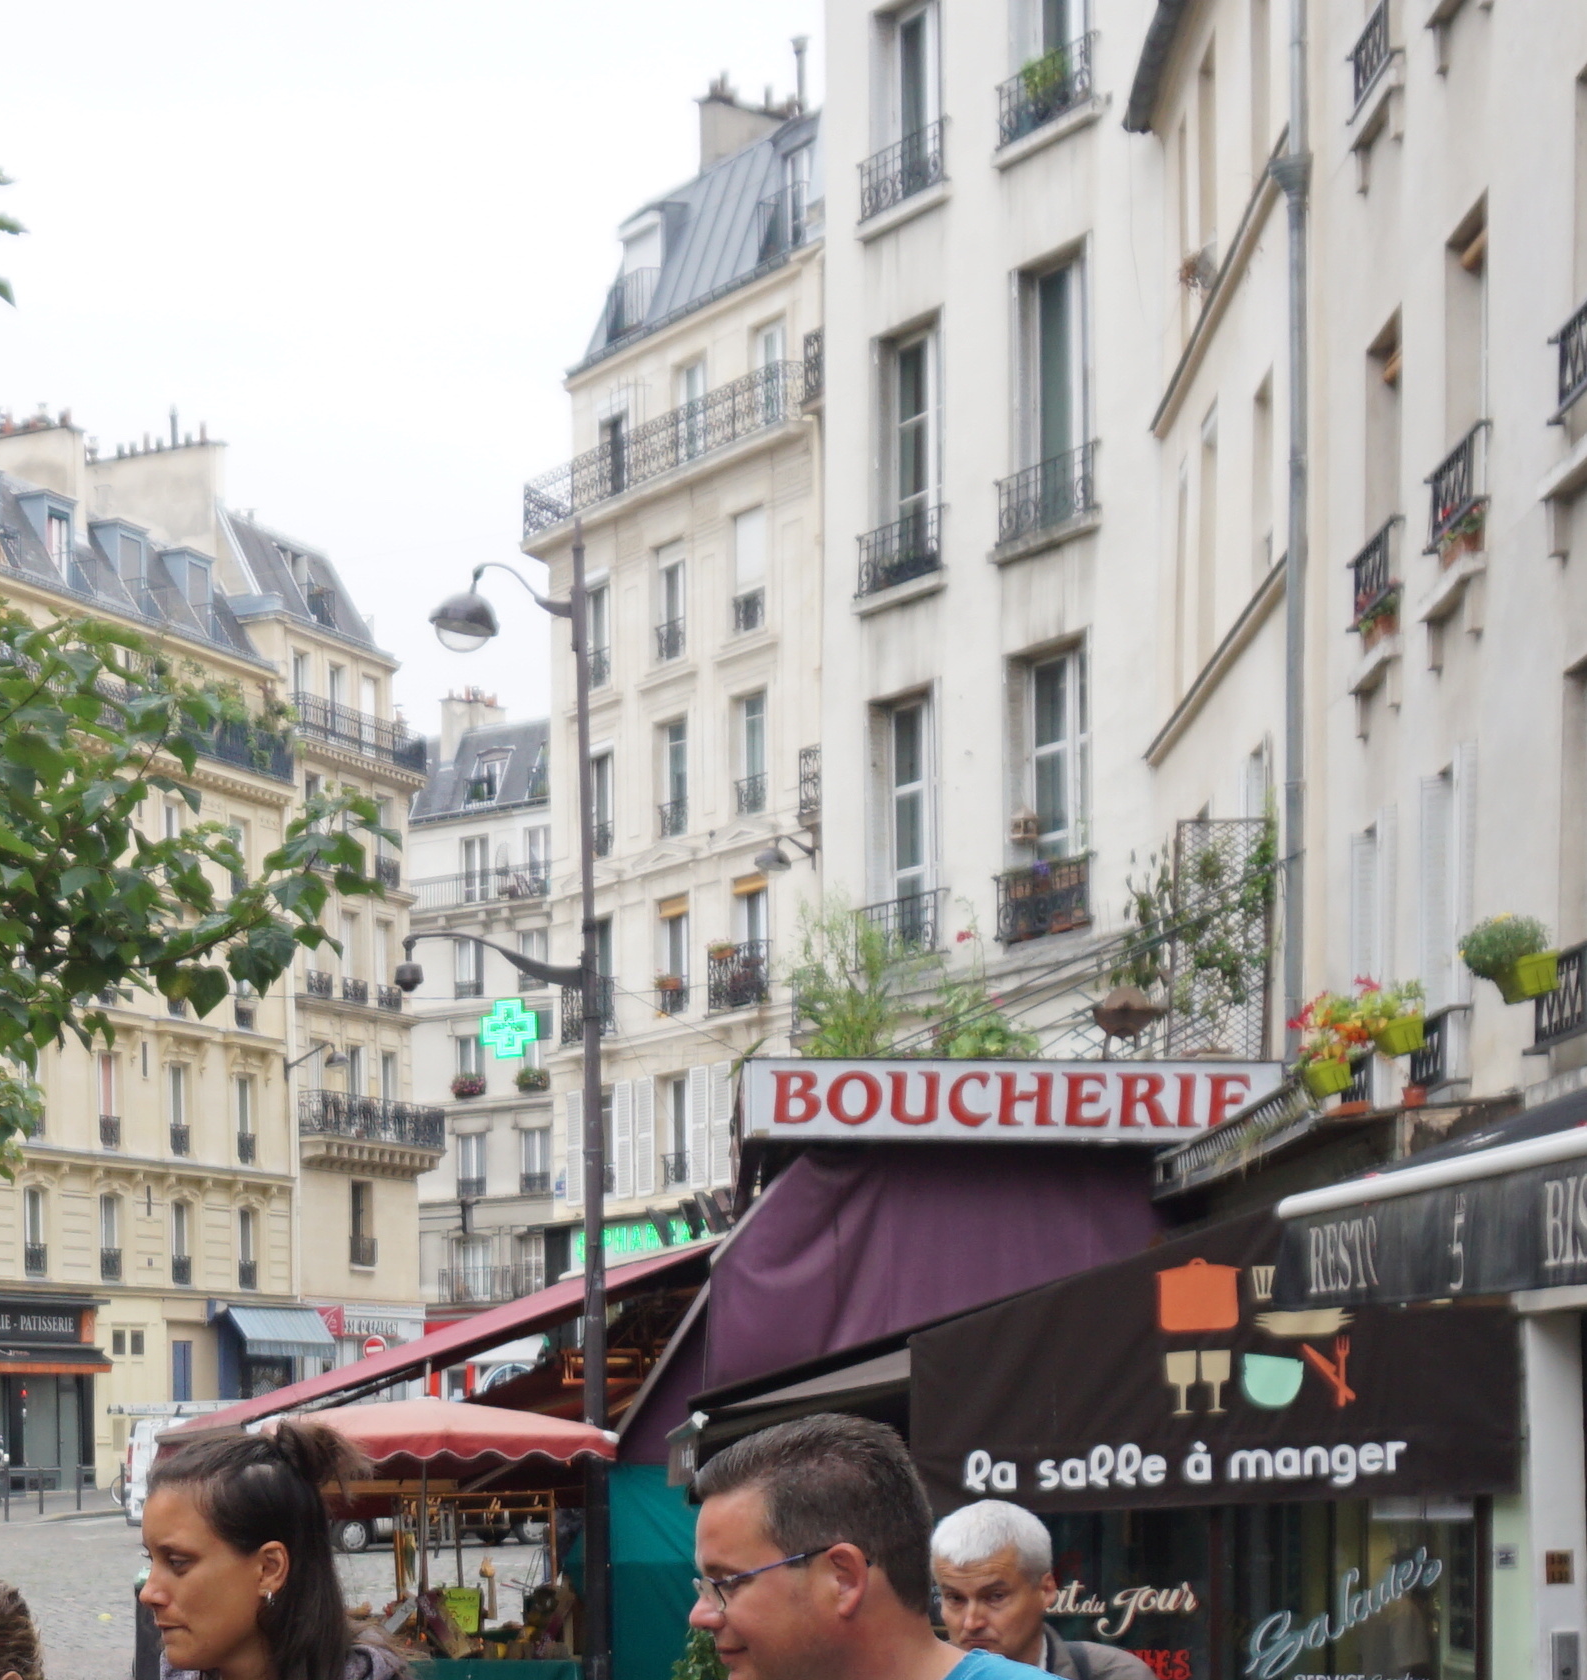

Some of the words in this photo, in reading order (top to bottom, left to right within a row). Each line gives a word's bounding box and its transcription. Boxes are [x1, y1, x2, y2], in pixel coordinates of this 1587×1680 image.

[771, 1069, 1251, 1128] BOUCHERIE
[19, 1314, 75, 1332] PATISSERIE
[965, 1448, 1017, 1492] la
[1035, 1442, 1168, 1490] salle
[1184, 1440, 1213, 1482] à
[1229, 1440, 1408, 1486] manger
